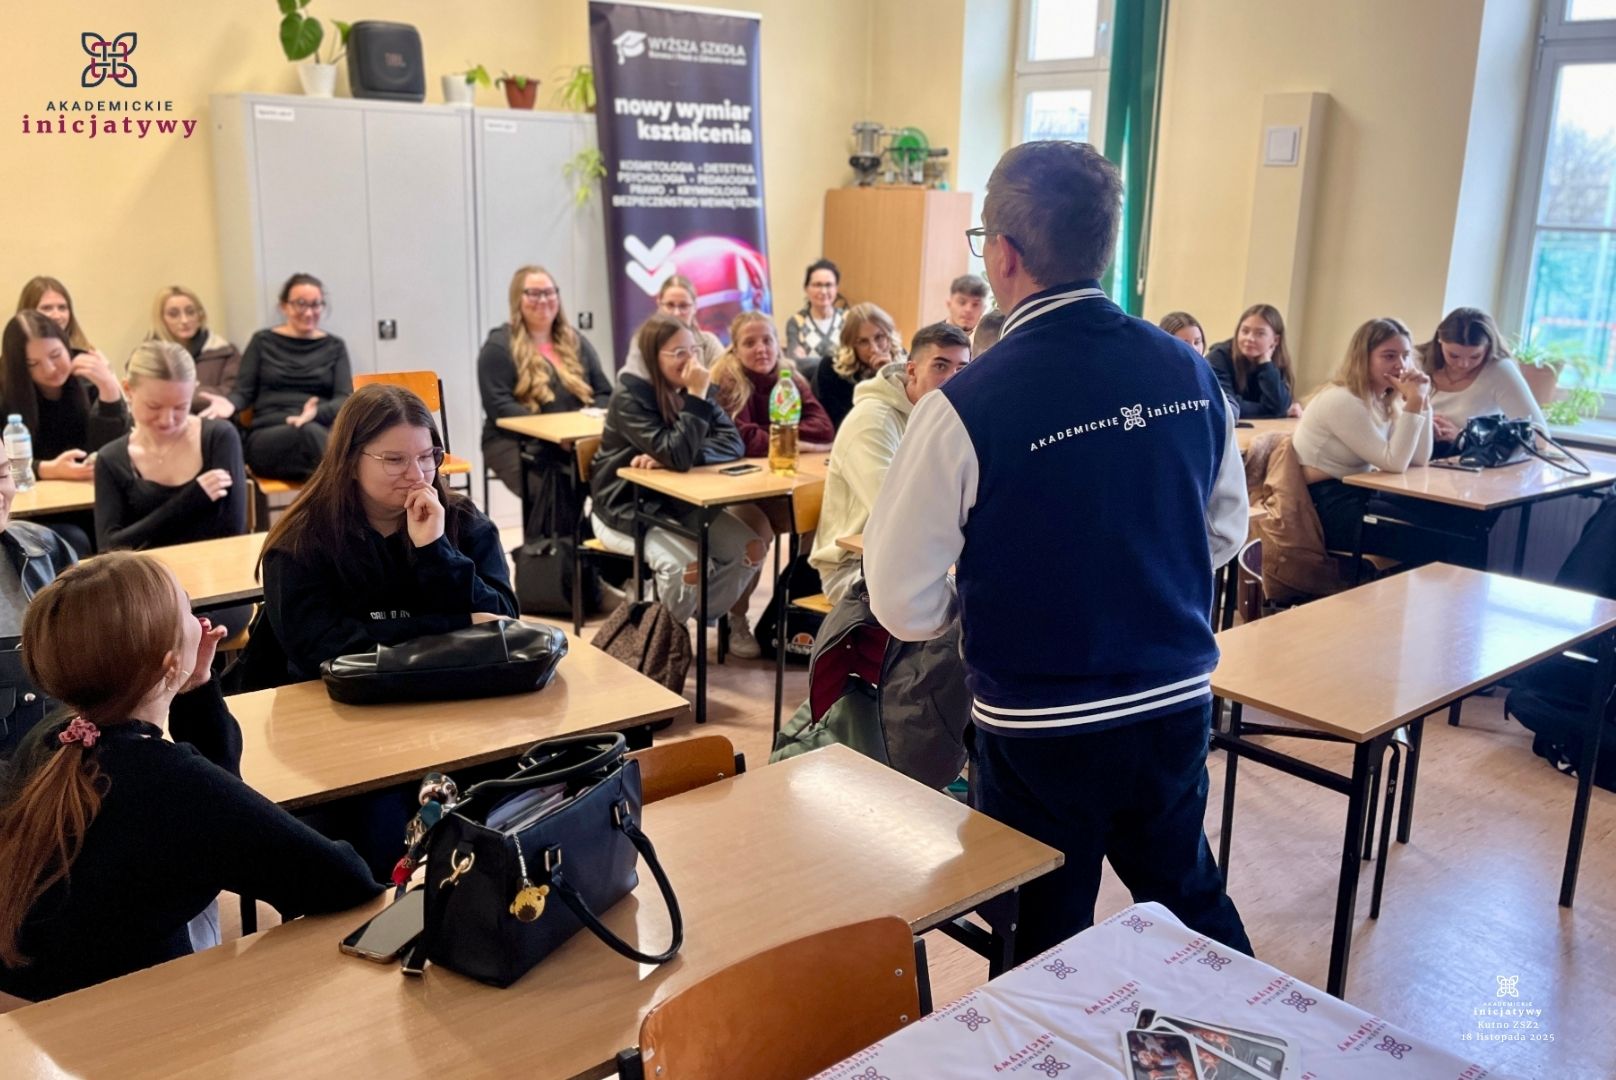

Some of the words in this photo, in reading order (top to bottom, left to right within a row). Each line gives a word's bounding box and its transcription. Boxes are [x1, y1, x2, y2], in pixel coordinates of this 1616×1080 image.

[614, 97, 672, 122] nowy
[676, 99, 752, 124] wymiar
[637, 119, 753, 145] kształcenia
[1030, 416, 1120, 452] AKADEMICKIE
